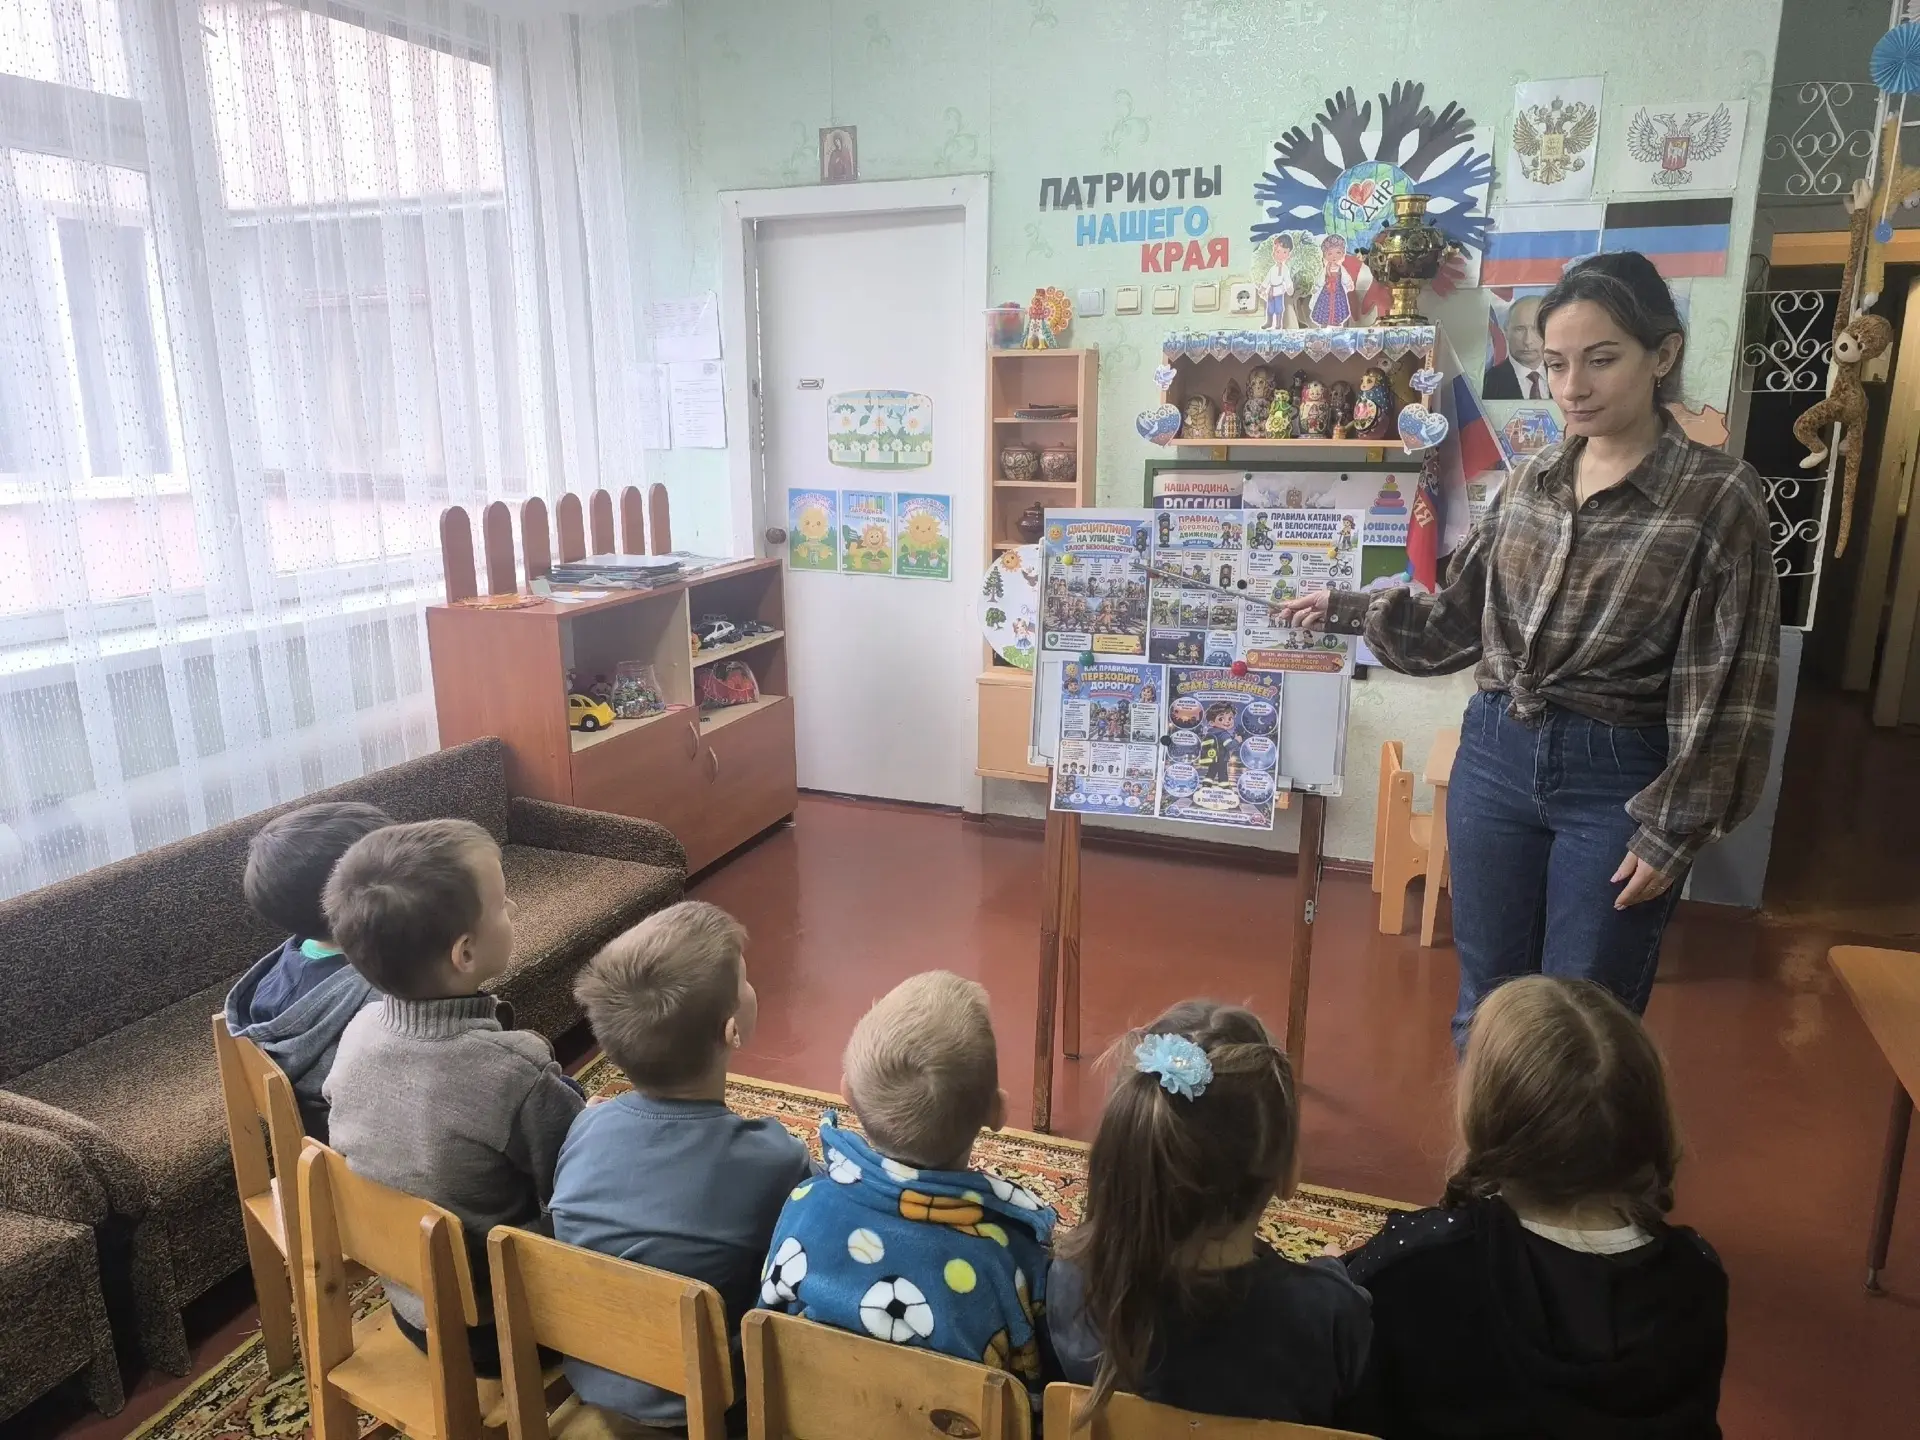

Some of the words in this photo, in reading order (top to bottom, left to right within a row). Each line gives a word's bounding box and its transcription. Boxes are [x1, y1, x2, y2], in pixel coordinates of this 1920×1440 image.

[1039, 165, 1221, 212] ПАТРИОТЫ
[1363, 180, 1393, 222] ДНР
[1076, 205, 1209, 246] НАШЕГО
[1141, 237, 1230, 273] КРАЯ
[1164, 483, 1190, 493] НАША
[1192, 483, 1228, 493] РОДИНА
[1178, 515, 1220, 523] ПРАВИЛА
[1270, 513, 1306, 521] ПРАВИЛА
[1307, 513, 1341, 522] КАТАНИЯ
[1067, 524, 1131, 535] ДИСЦИПЛИНА
[1273, 522, 1283, 530] НА
[1285, 522, 1337, 531] ВЕЛОСИПЕДАХ
[1076, 535, 1088, 543] НА
[1089, 535, 1115, 543] УЛИЦЕ
[1179, 531, 1218, 539] ДВИЖЕНИЯ
[1284, 531, 1333, 540] САМОКАТАХ
[1099, 665, 1138, 674] ПРАВИЛЬНО
[1081, 672, 1141, 684] ПЕРЕХОДИТЬ
[1223, 670, 1260, 684] ННО
[1090, 682, 1134, 692] ДОРОГУ?
[1177, 680, 1210, 694] СТАТЬ
[1212, 680, 1278, 699] ЗАМЕТНЕЕ?
